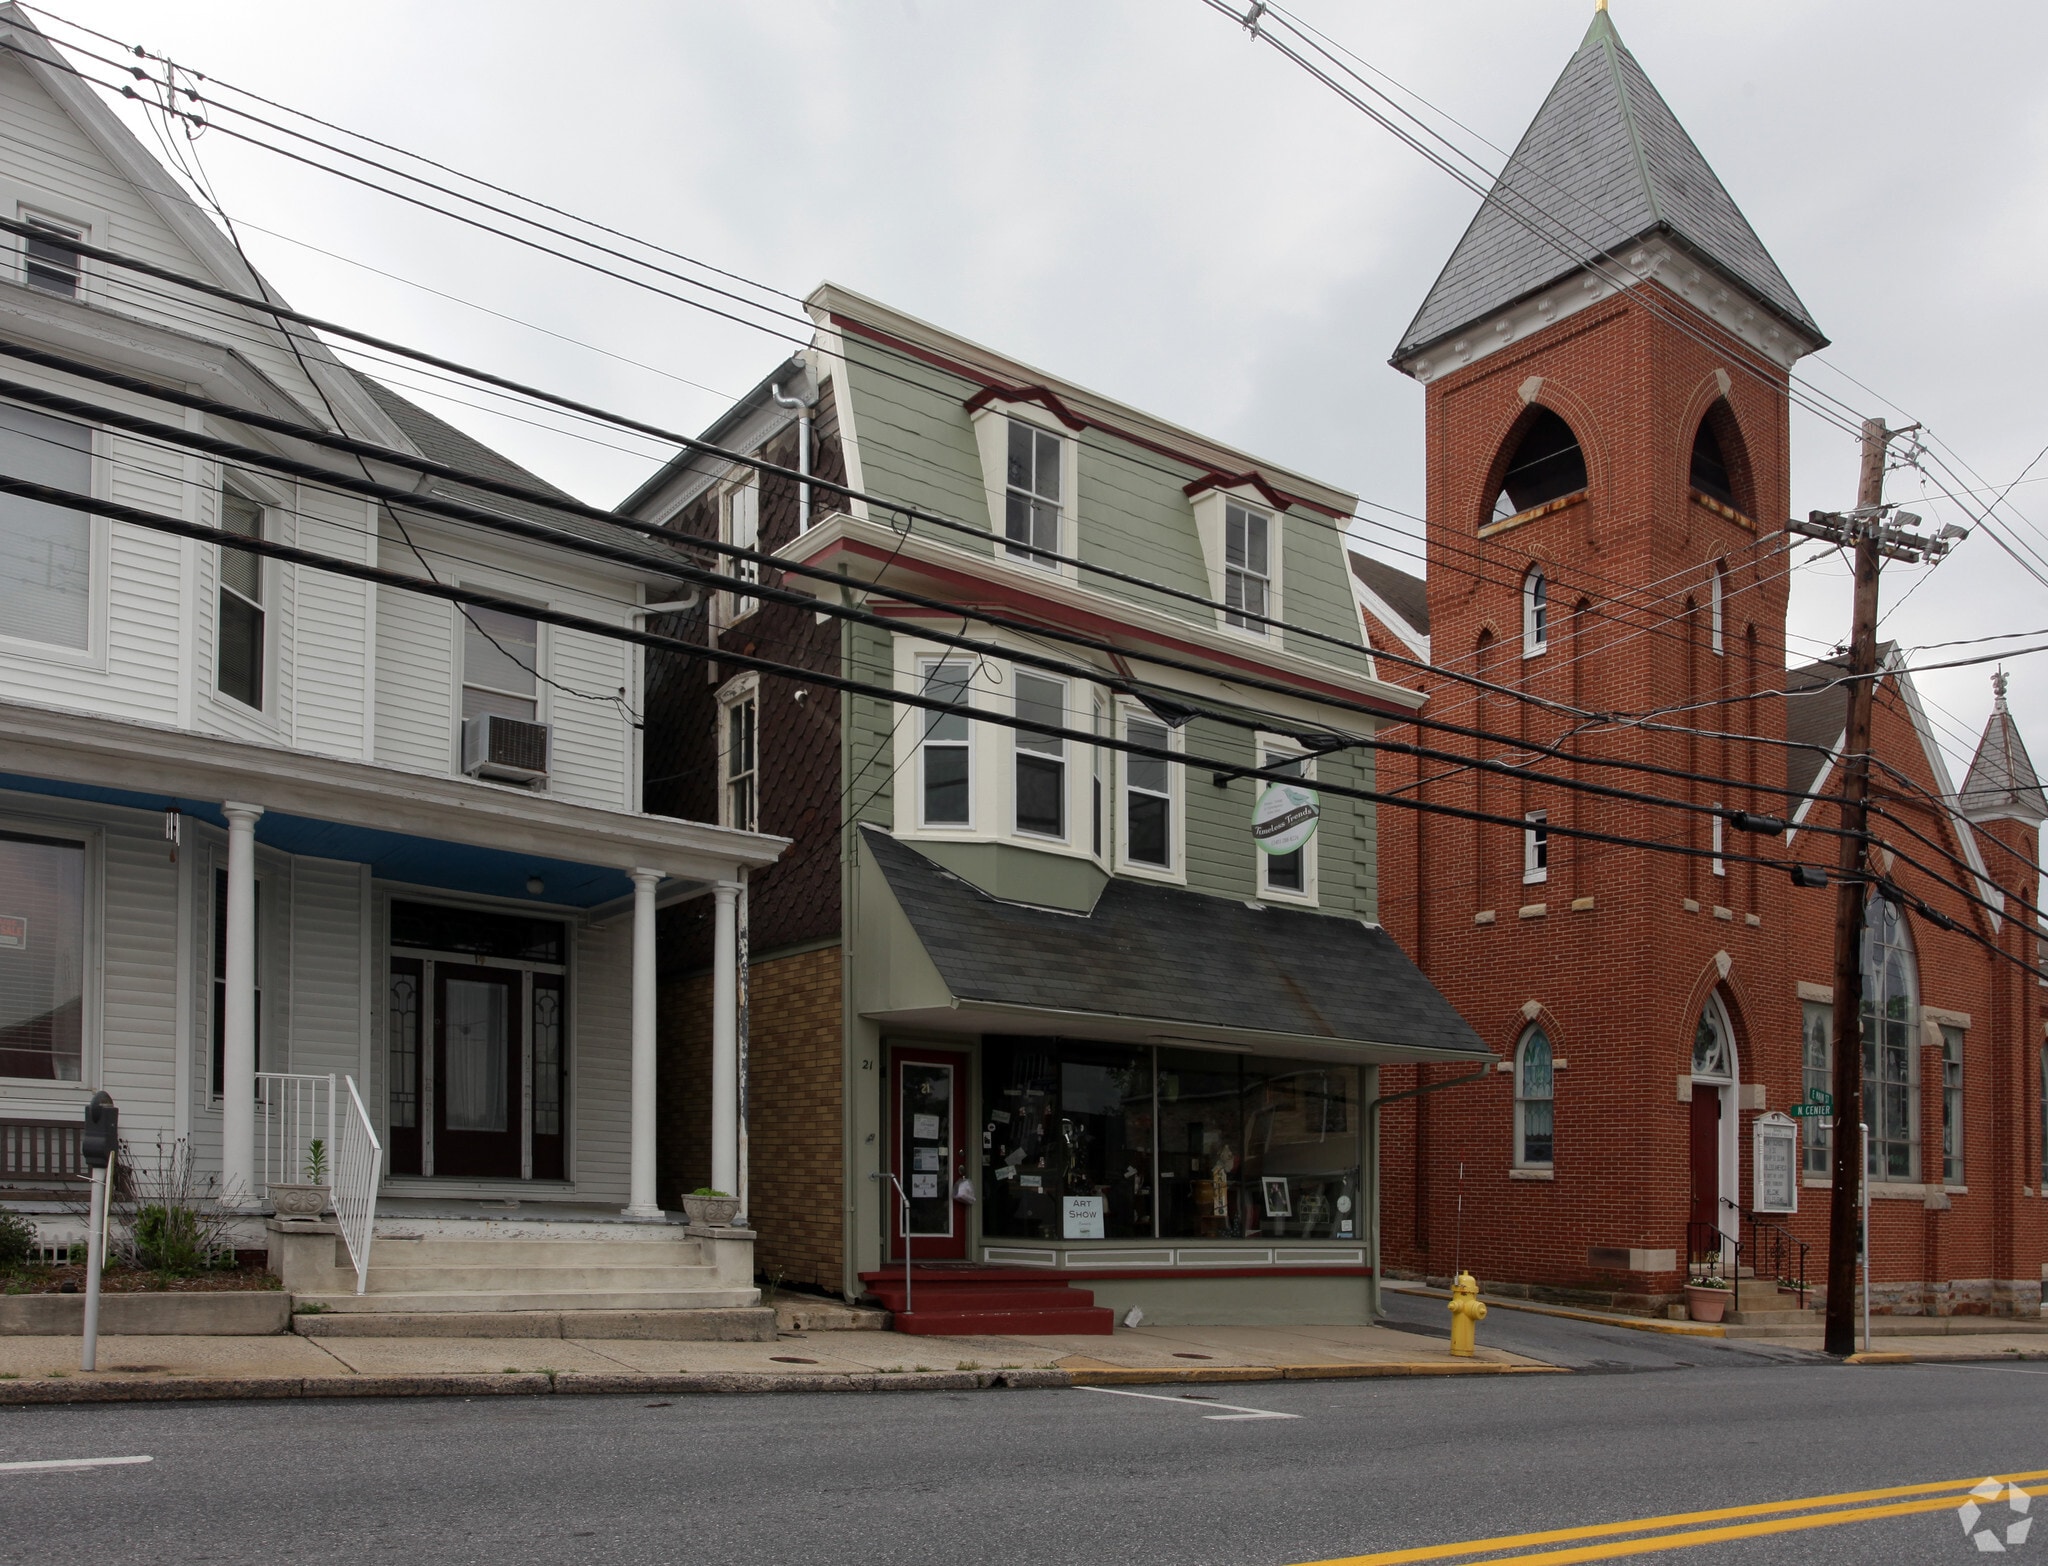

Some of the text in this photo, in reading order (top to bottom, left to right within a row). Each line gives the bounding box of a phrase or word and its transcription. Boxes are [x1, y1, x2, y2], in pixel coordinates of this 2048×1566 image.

[1255, 821, 1286, 835] Timeless
[1285, 807, 1312, 823] Trends
[862, 1060, 873, 1070] 21
[921, 1083, 931, 1094] 21
[1805, 1106, 1830, 1115] CENTER
